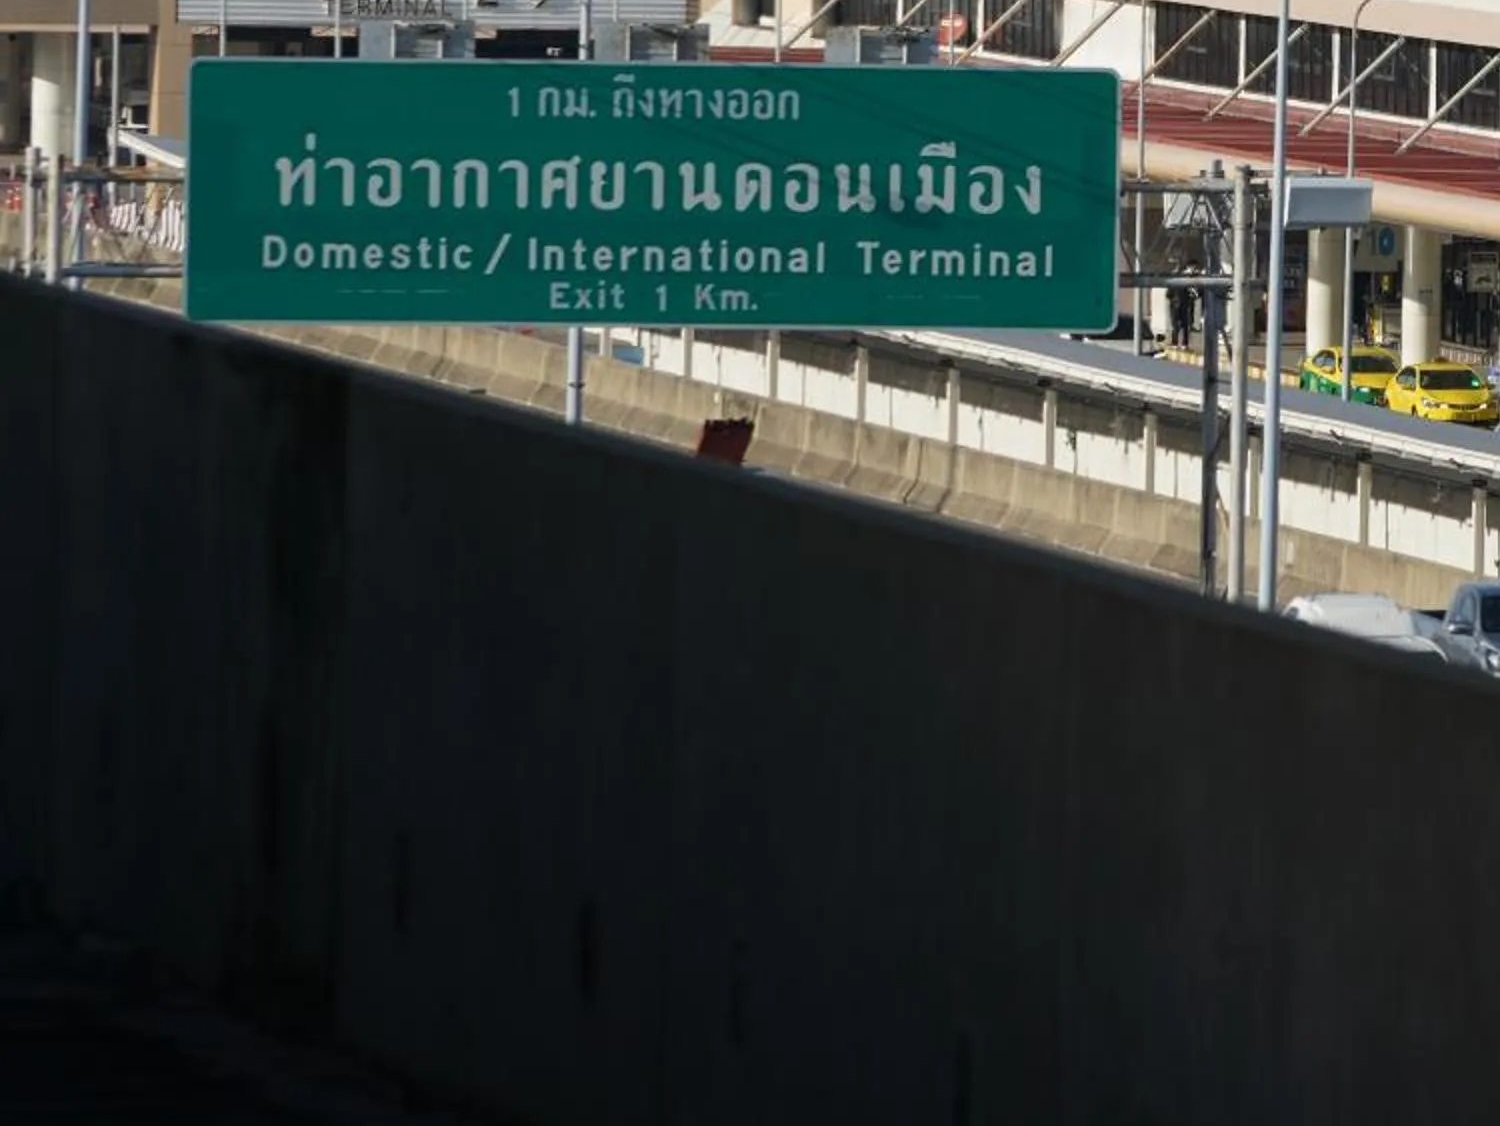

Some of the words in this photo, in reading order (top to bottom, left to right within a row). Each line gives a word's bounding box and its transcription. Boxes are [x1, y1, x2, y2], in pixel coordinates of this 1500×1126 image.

[508, 86, 520, 118] 1
[538, 86, 597, 119] กม.
[612, 73, 800, 121] ถึงทางออก
[275, 132, 1042, 216] ท่าอากาศยานดอนเมือง
[262, 234, 473, 270] Domestic
[528, 236, 826, 273] International
[856, 240, 1054, 278] Terminal
[549, 279, 625, 310] Exit
[656, 285, 667, 313] 1
[694, 284, 759, 312] Km.
